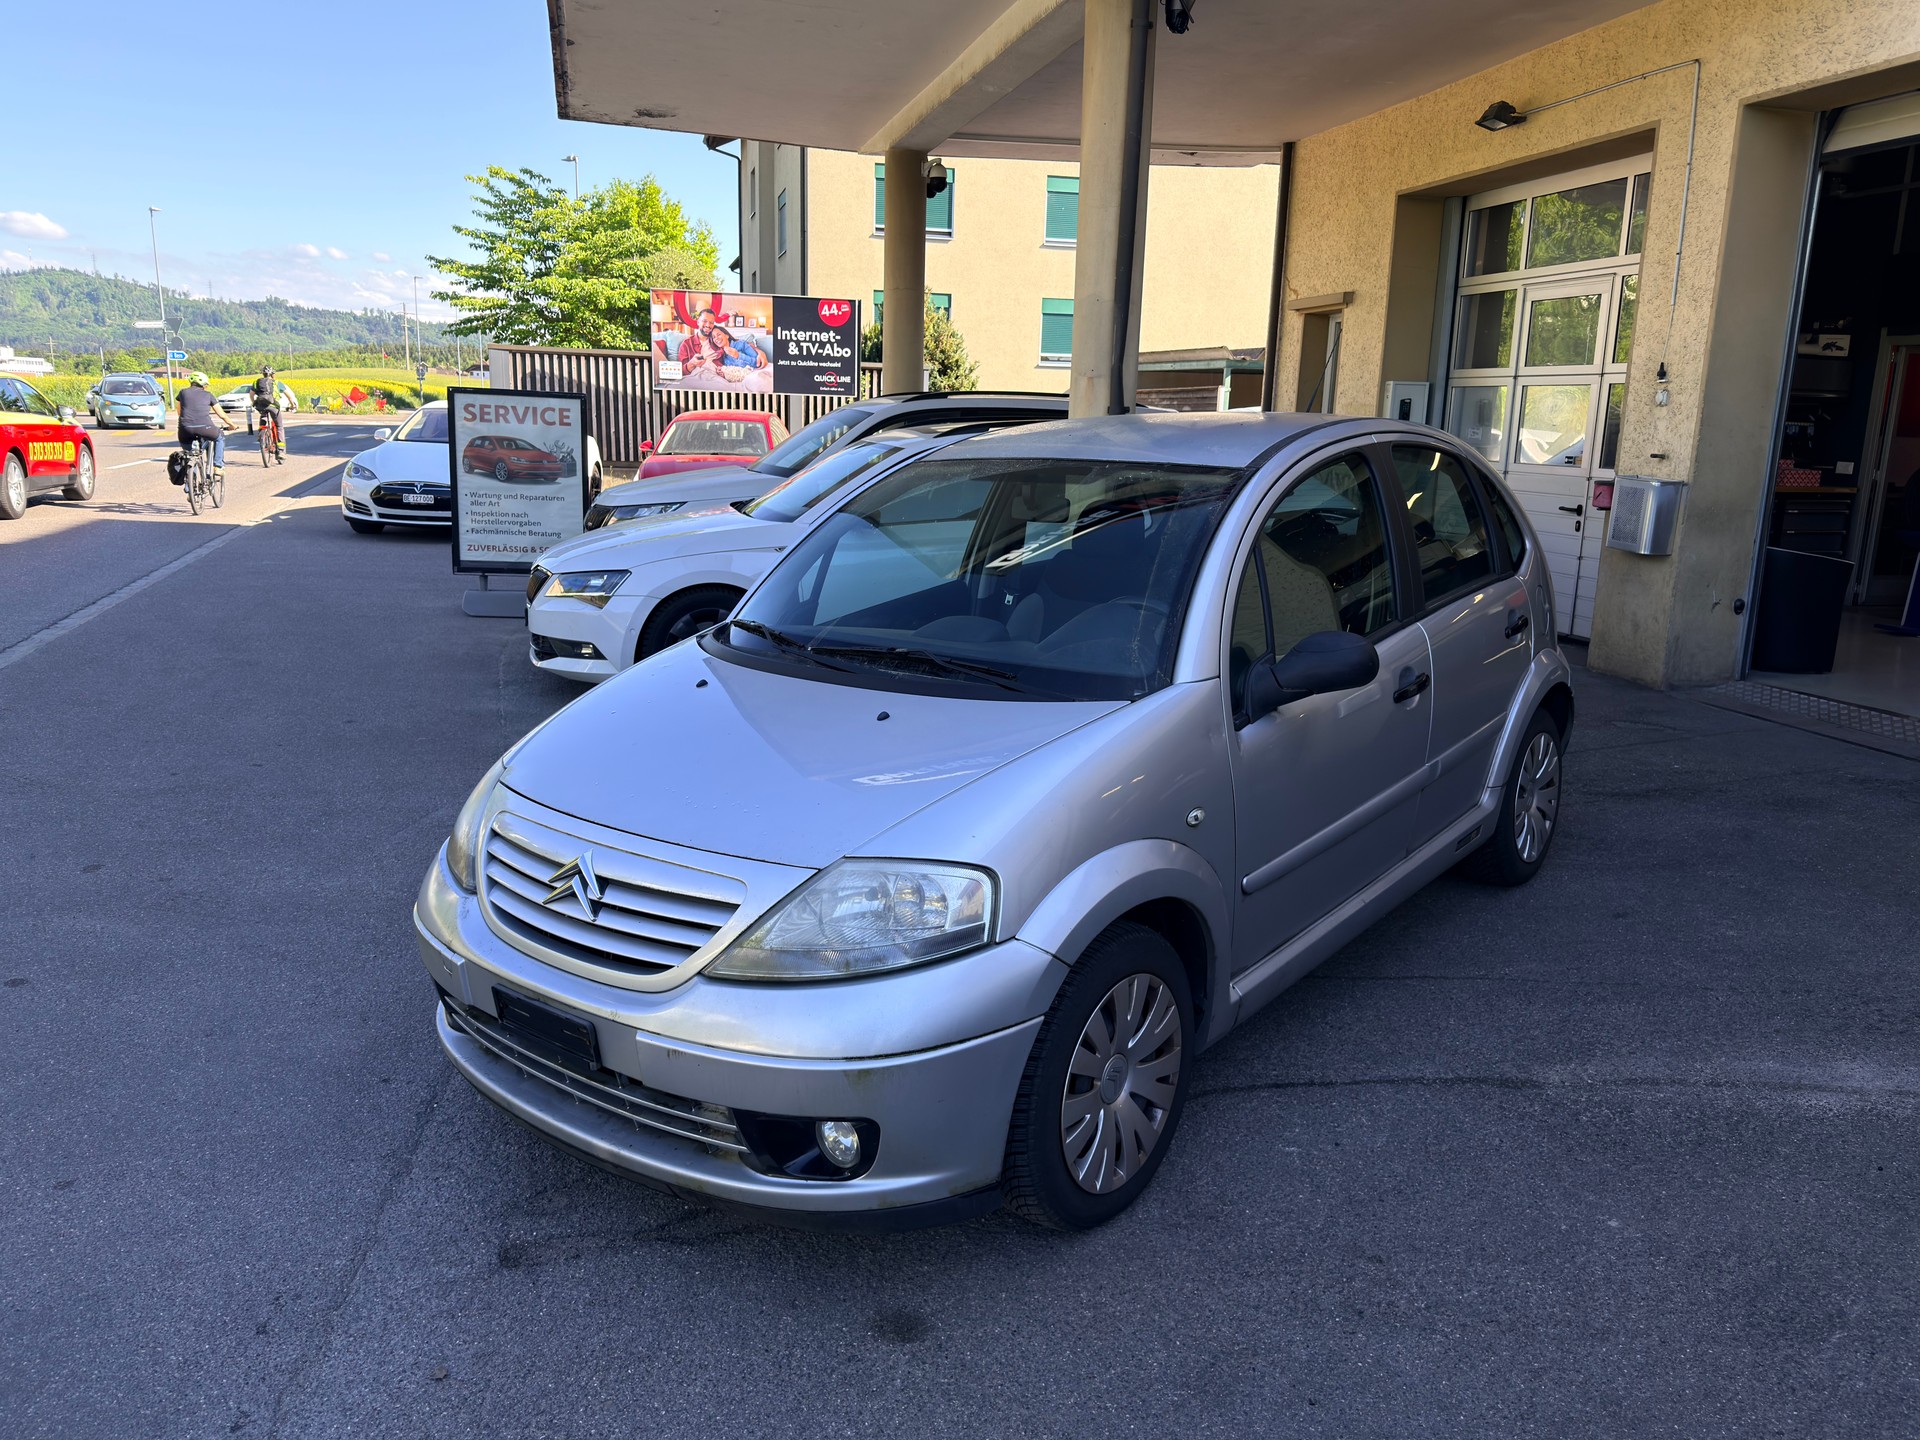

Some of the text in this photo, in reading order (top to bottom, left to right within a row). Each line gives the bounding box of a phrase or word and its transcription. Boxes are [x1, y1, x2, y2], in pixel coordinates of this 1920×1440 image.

[777, 326, 841, 342] Internet-
[788, 341, 852, 357] & TV-Abo
[463, 403, 572, 427] SERVICE
[469, 491, 502, 501] Wartung
[520, 493, 565, 502] Reparaturen
[470, 510, 510, 518] Inspektion
[471, 518, 542, 528] Herstellervorgaben
[471, 527, 562, 539] Fachmännische Beratung
[467, 544, 529, 553] ZUVERLÄSSIG
